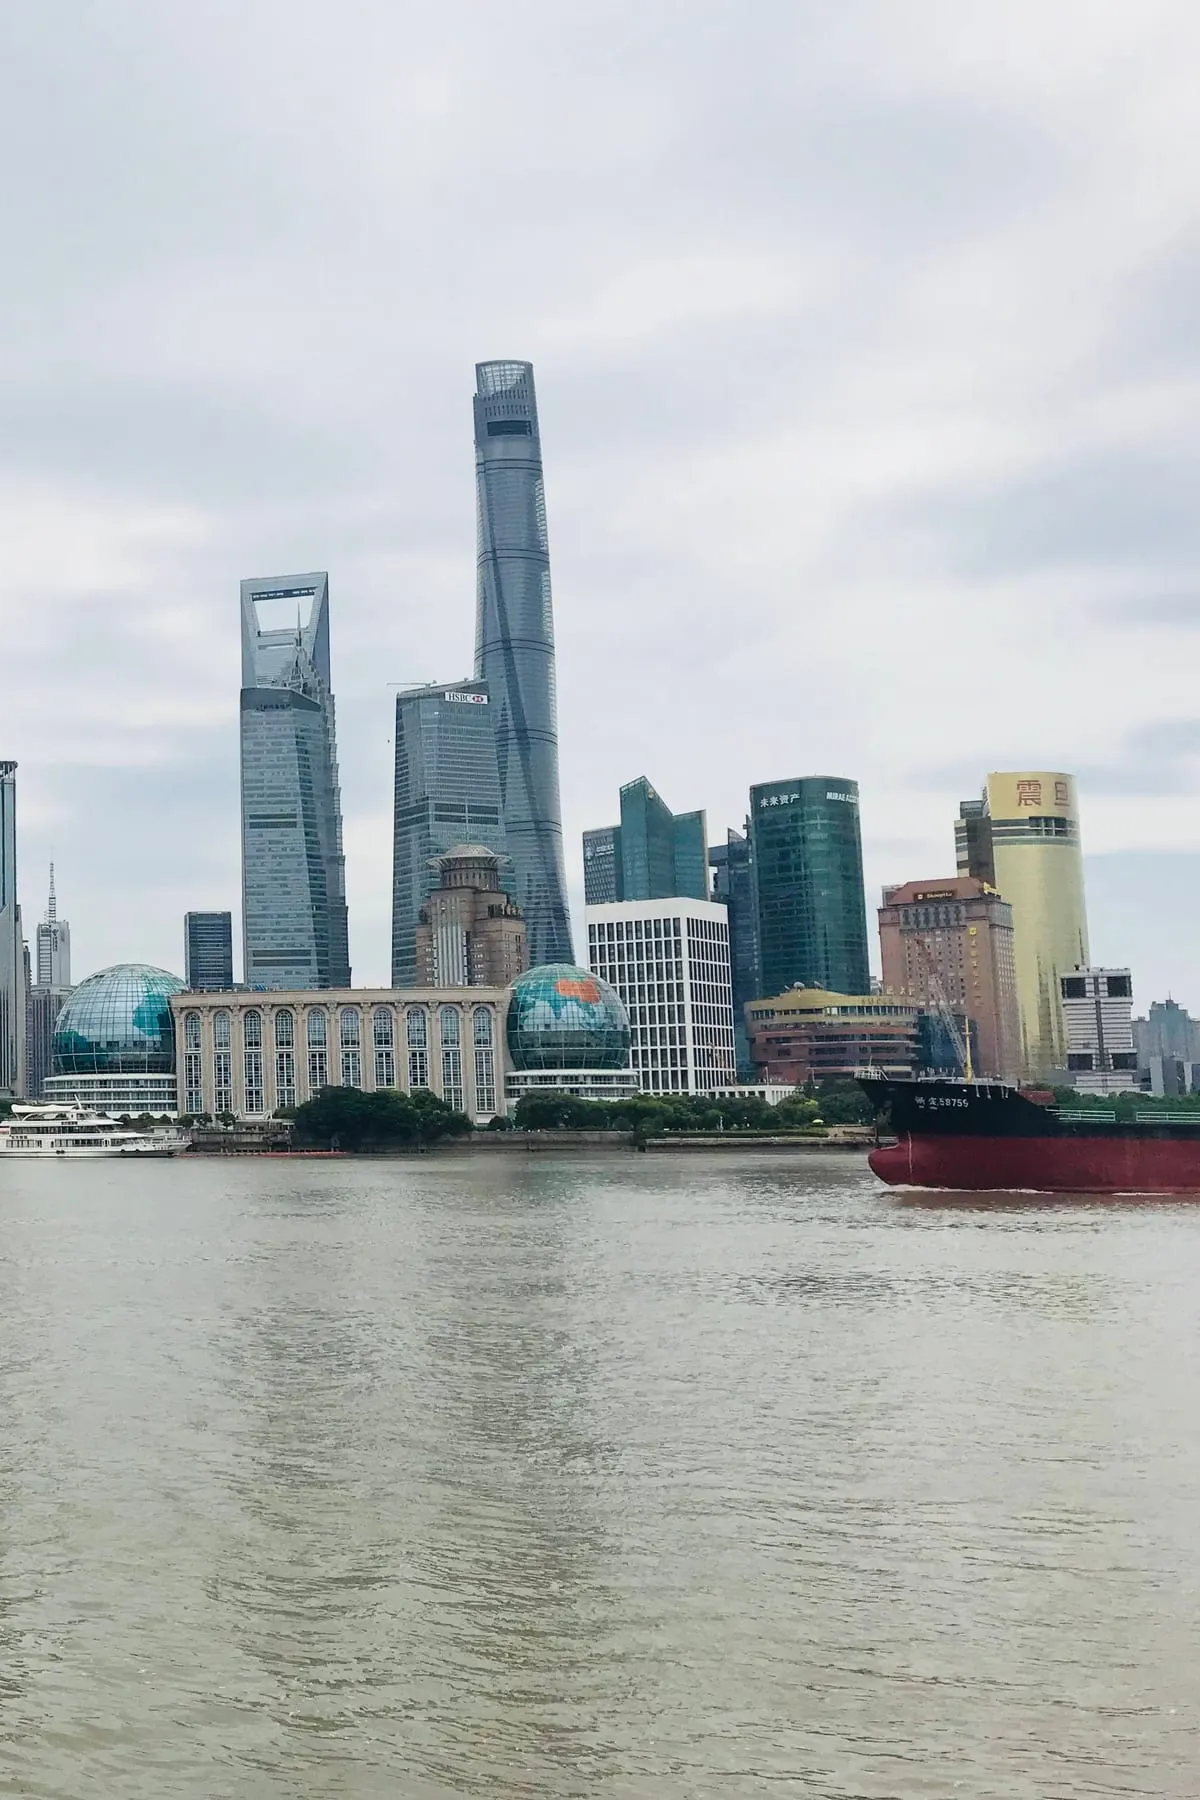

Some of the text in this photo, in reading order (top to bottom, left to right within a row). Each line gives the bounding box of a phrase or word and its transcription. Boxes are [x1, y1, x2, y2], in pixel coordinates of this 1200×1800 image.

[448, 693, 472, 702] HSBC
[826, 792, 846, 802] MIRAE
[1016, 780, 1071, 806] 震旦
[760, 793, 800, 808] 未来资产
